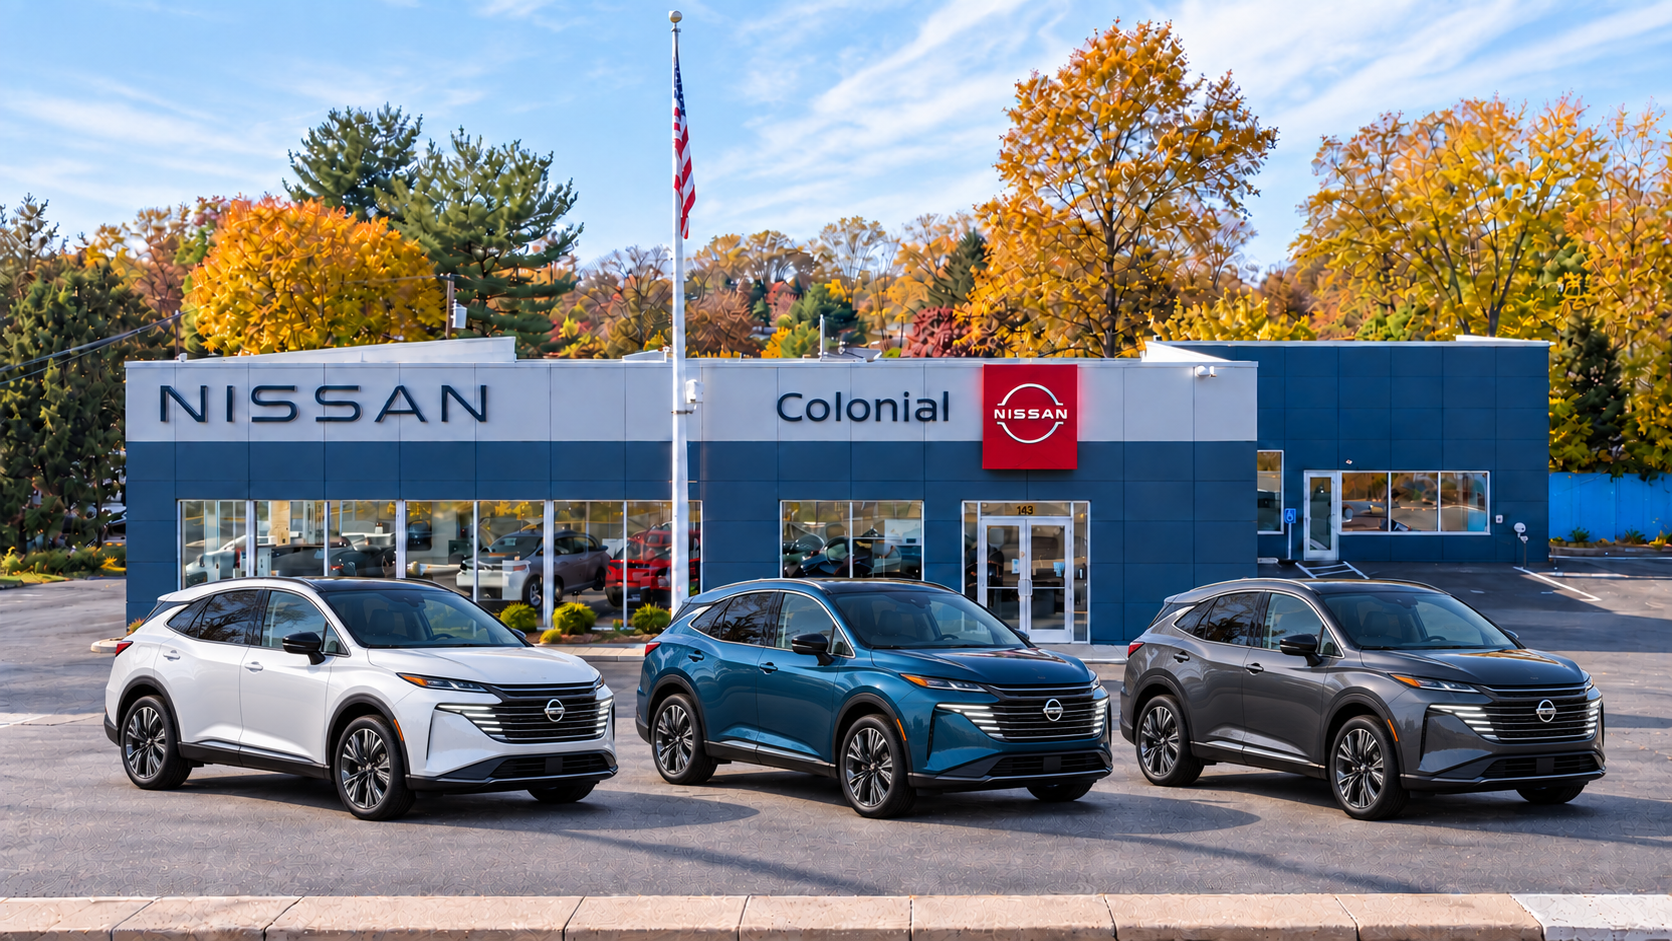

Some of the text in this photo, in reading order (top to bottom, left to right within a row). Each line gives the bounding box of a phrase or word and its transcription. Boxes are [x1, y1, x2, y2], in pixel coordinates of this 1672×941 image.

[160, 384, 488, 423] NISSAN
[777, 391, 949, 422] Colonial
[994, 408, 1068, 420] NISSAN
[1016, 505, 1034, 515] 143
